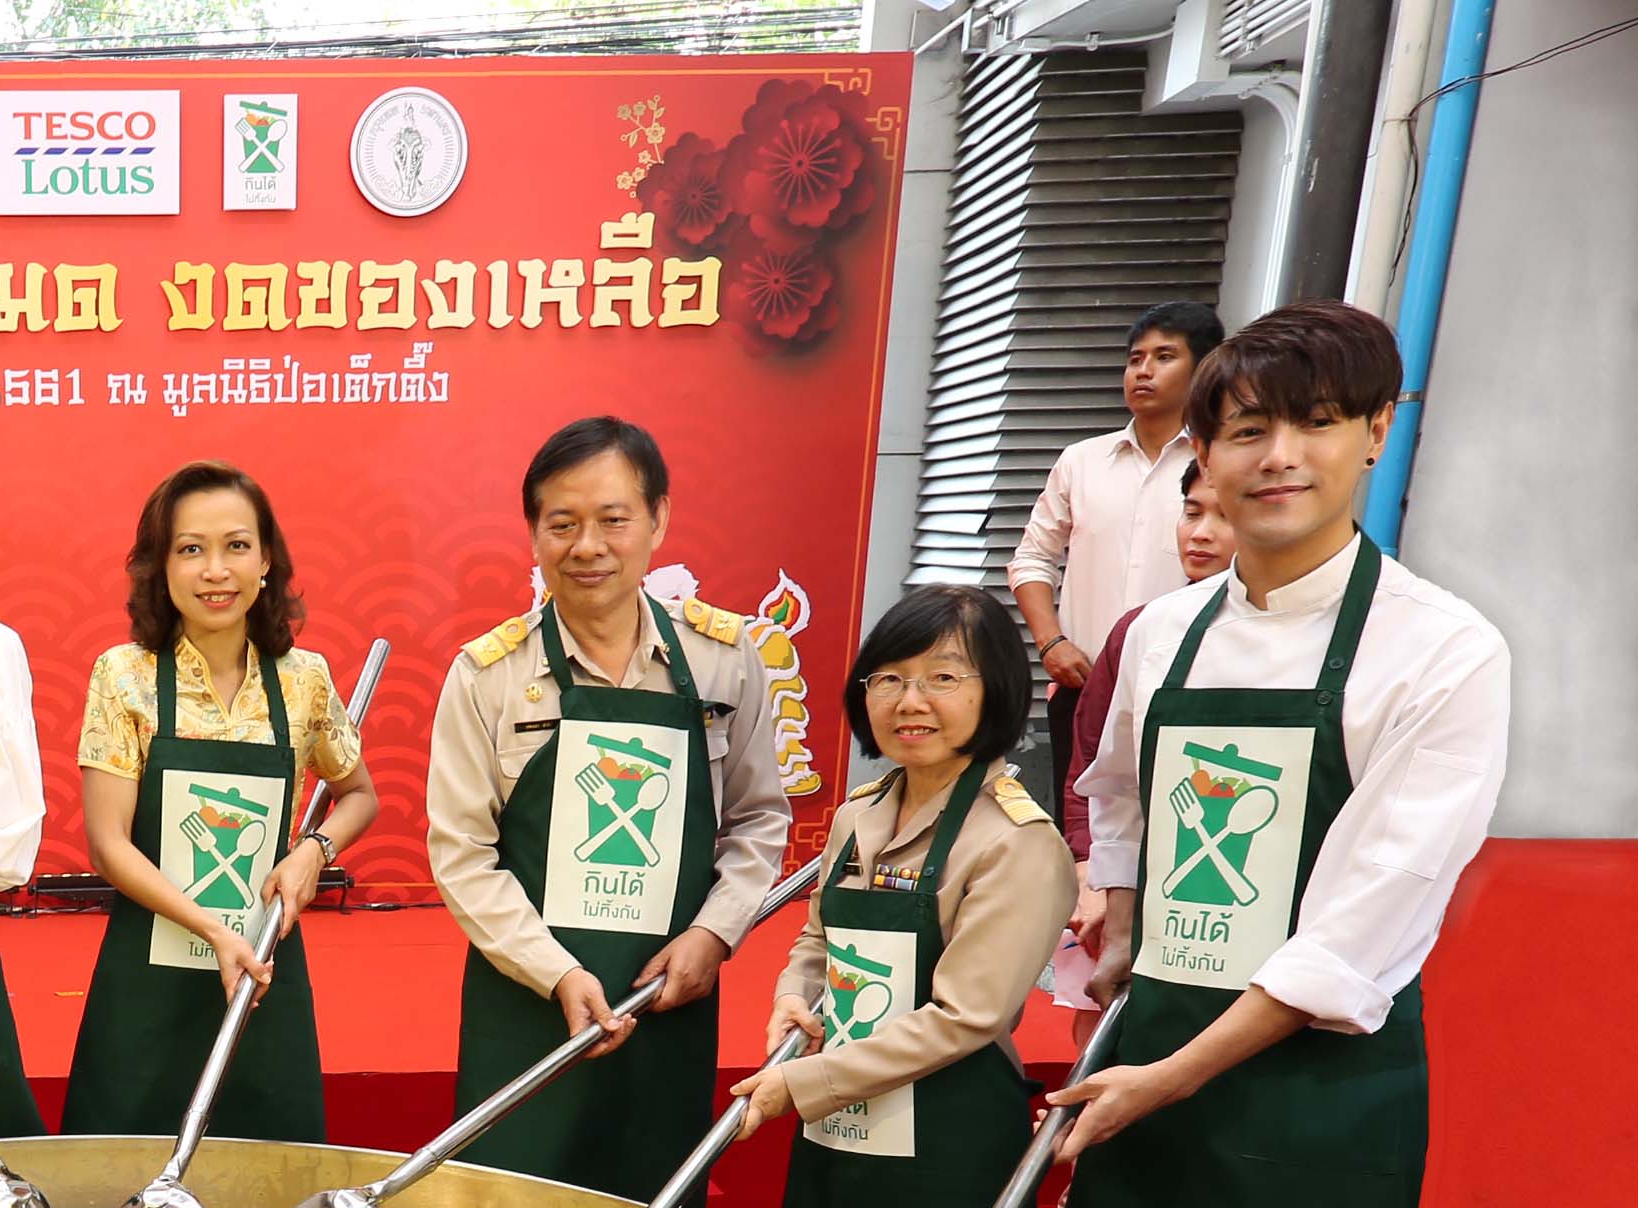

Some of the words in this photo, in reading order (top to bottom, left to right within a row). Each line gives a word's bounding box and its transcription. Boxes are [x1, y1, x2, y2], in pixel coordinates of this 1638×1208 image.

[13, 111, 157, 141] TESCO
[21, 158, 155, 196] Lotus
[160, 212, 723, 331] งดของเหลือ
[107, 373, 147, 404] ณ
[585, 870, 646, 897] กินได้
[583, 898, 641, 920] ไม่ทิ้งกัน
[1165, 909, 1233, 943] กินได้
[1161, 945, 1225, 972] ไม่ทิ้งกัน
